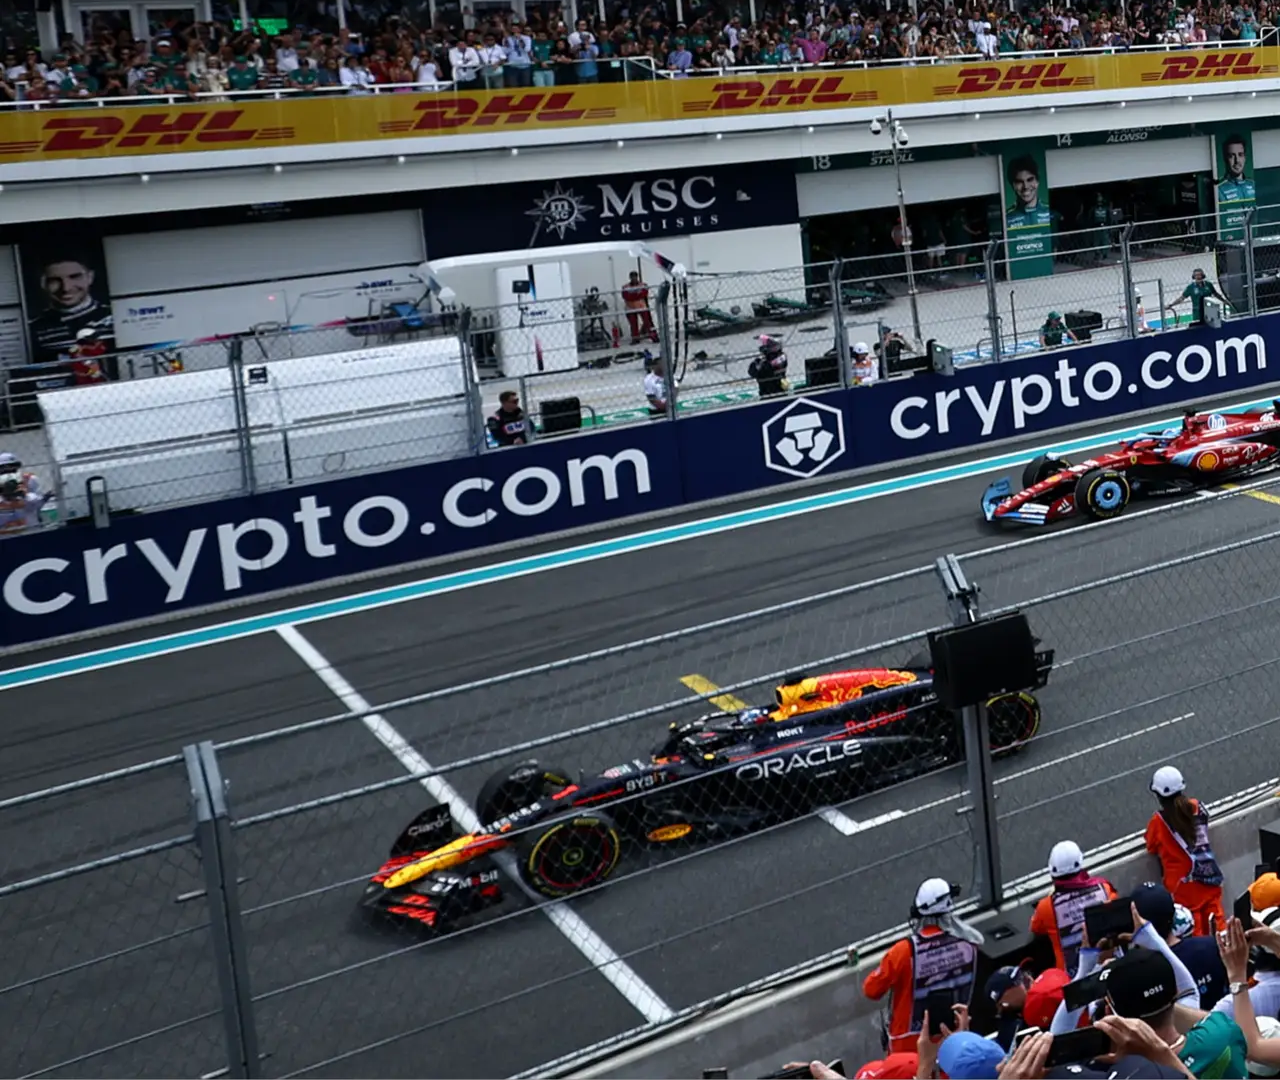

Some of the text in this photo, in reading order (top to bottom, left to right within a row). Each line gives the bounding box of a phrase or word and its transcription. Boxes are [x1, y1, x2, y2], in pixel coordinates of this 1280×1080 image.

[956, 62, 1073, 94] DHL
[1161, 52, 1261, 80] DHL
[711, 76, 857, 110] DHL
[415, 92, 587, 130] DHL
[42, 110, 257, 151] DHL
[1056, 133, 1072, 147] 14
[1106, 132, 1149, 143] ALONSO
[811, 155, 831, 170] 18
[599, 175, 717, 218] MSC
[600, 214, 719, 236] CRUISES
[889, 333, 1268, 439] crypto.com
[3, 448, 650, 614] crypto.com
[736, 739, 863, 781] ORACLE
[408, 813, 446, 837] Claro
[459, 870, 498, 890] Mobil
[1143, 984, 1164, 998] BOSS
